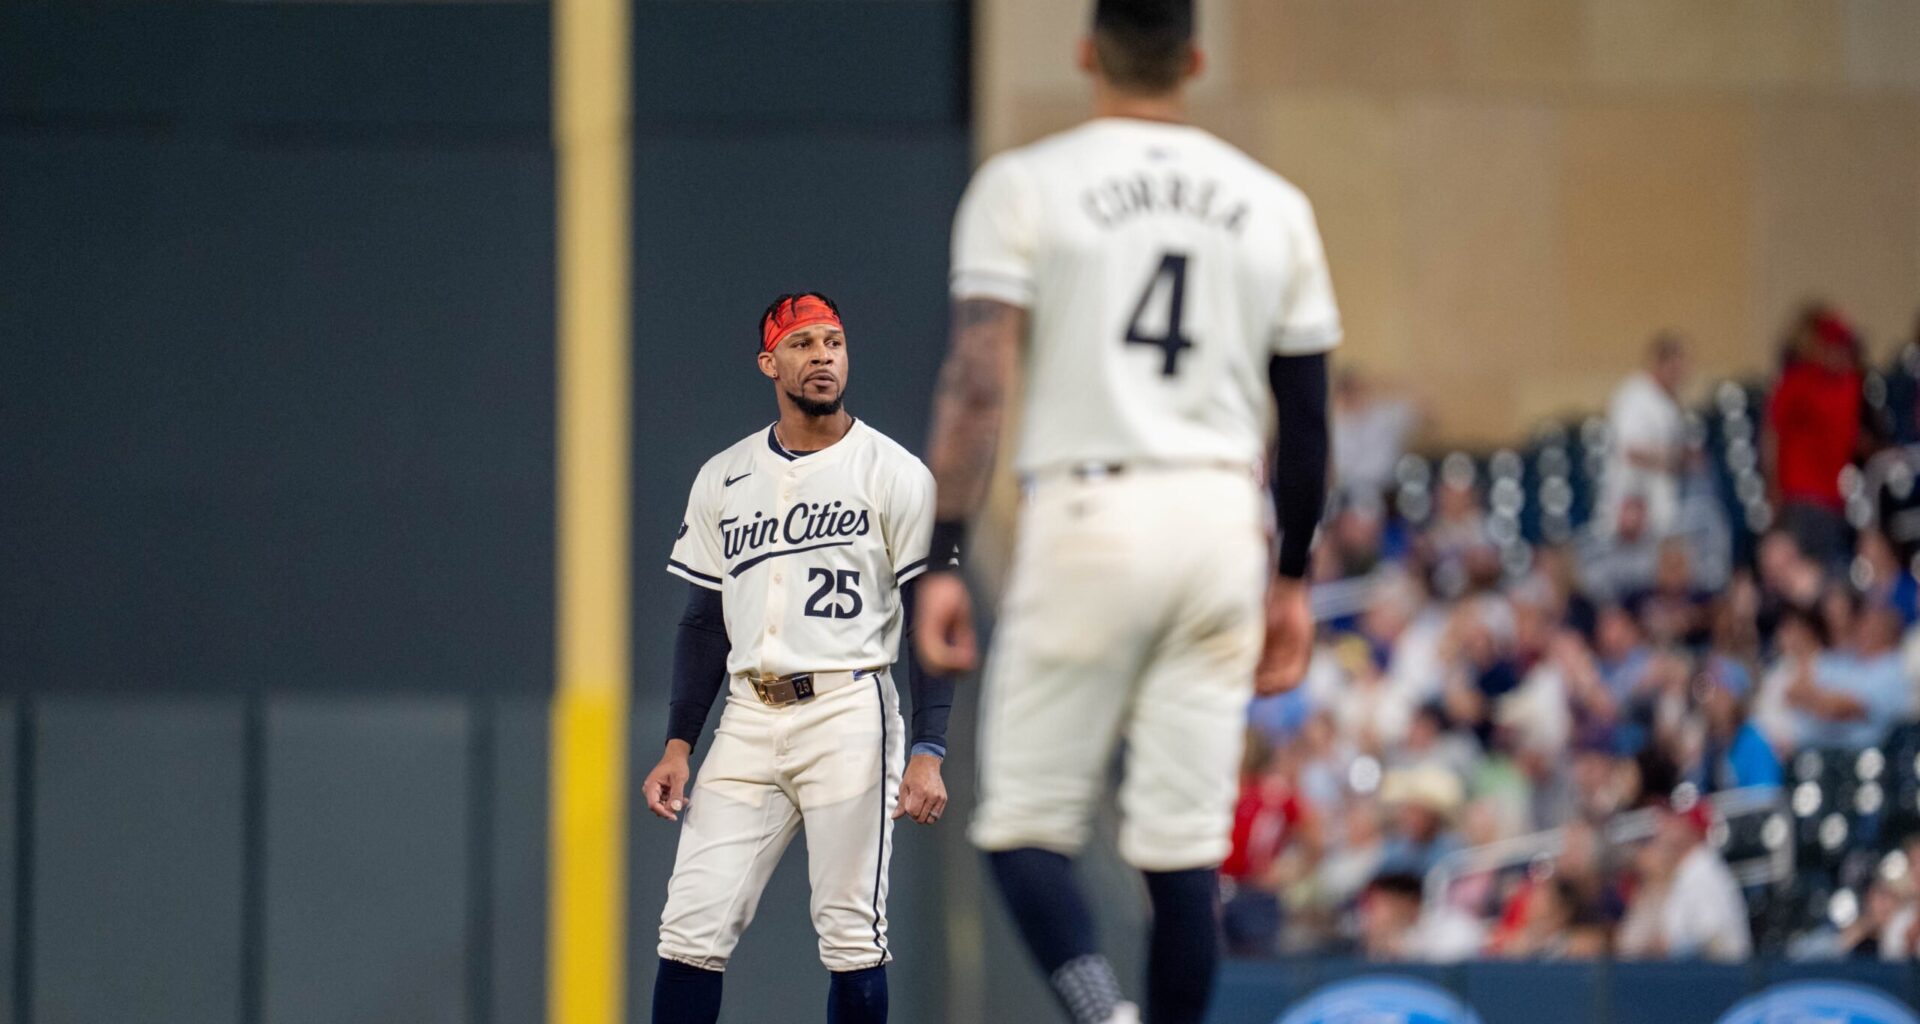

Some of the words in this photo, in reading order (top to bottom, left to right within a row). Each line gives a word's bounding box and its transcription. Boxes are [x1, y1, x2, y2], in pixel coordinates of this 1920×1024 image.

[1082, 173, 1250, 237] CORREA
[1123, 252, 1195, 378] 4
[719, 511, 779, 559] Twin
[783, 500, 870, 545] Cities
[804, 567, 863, 619] 25
[796, 680, 810, 694] 25
